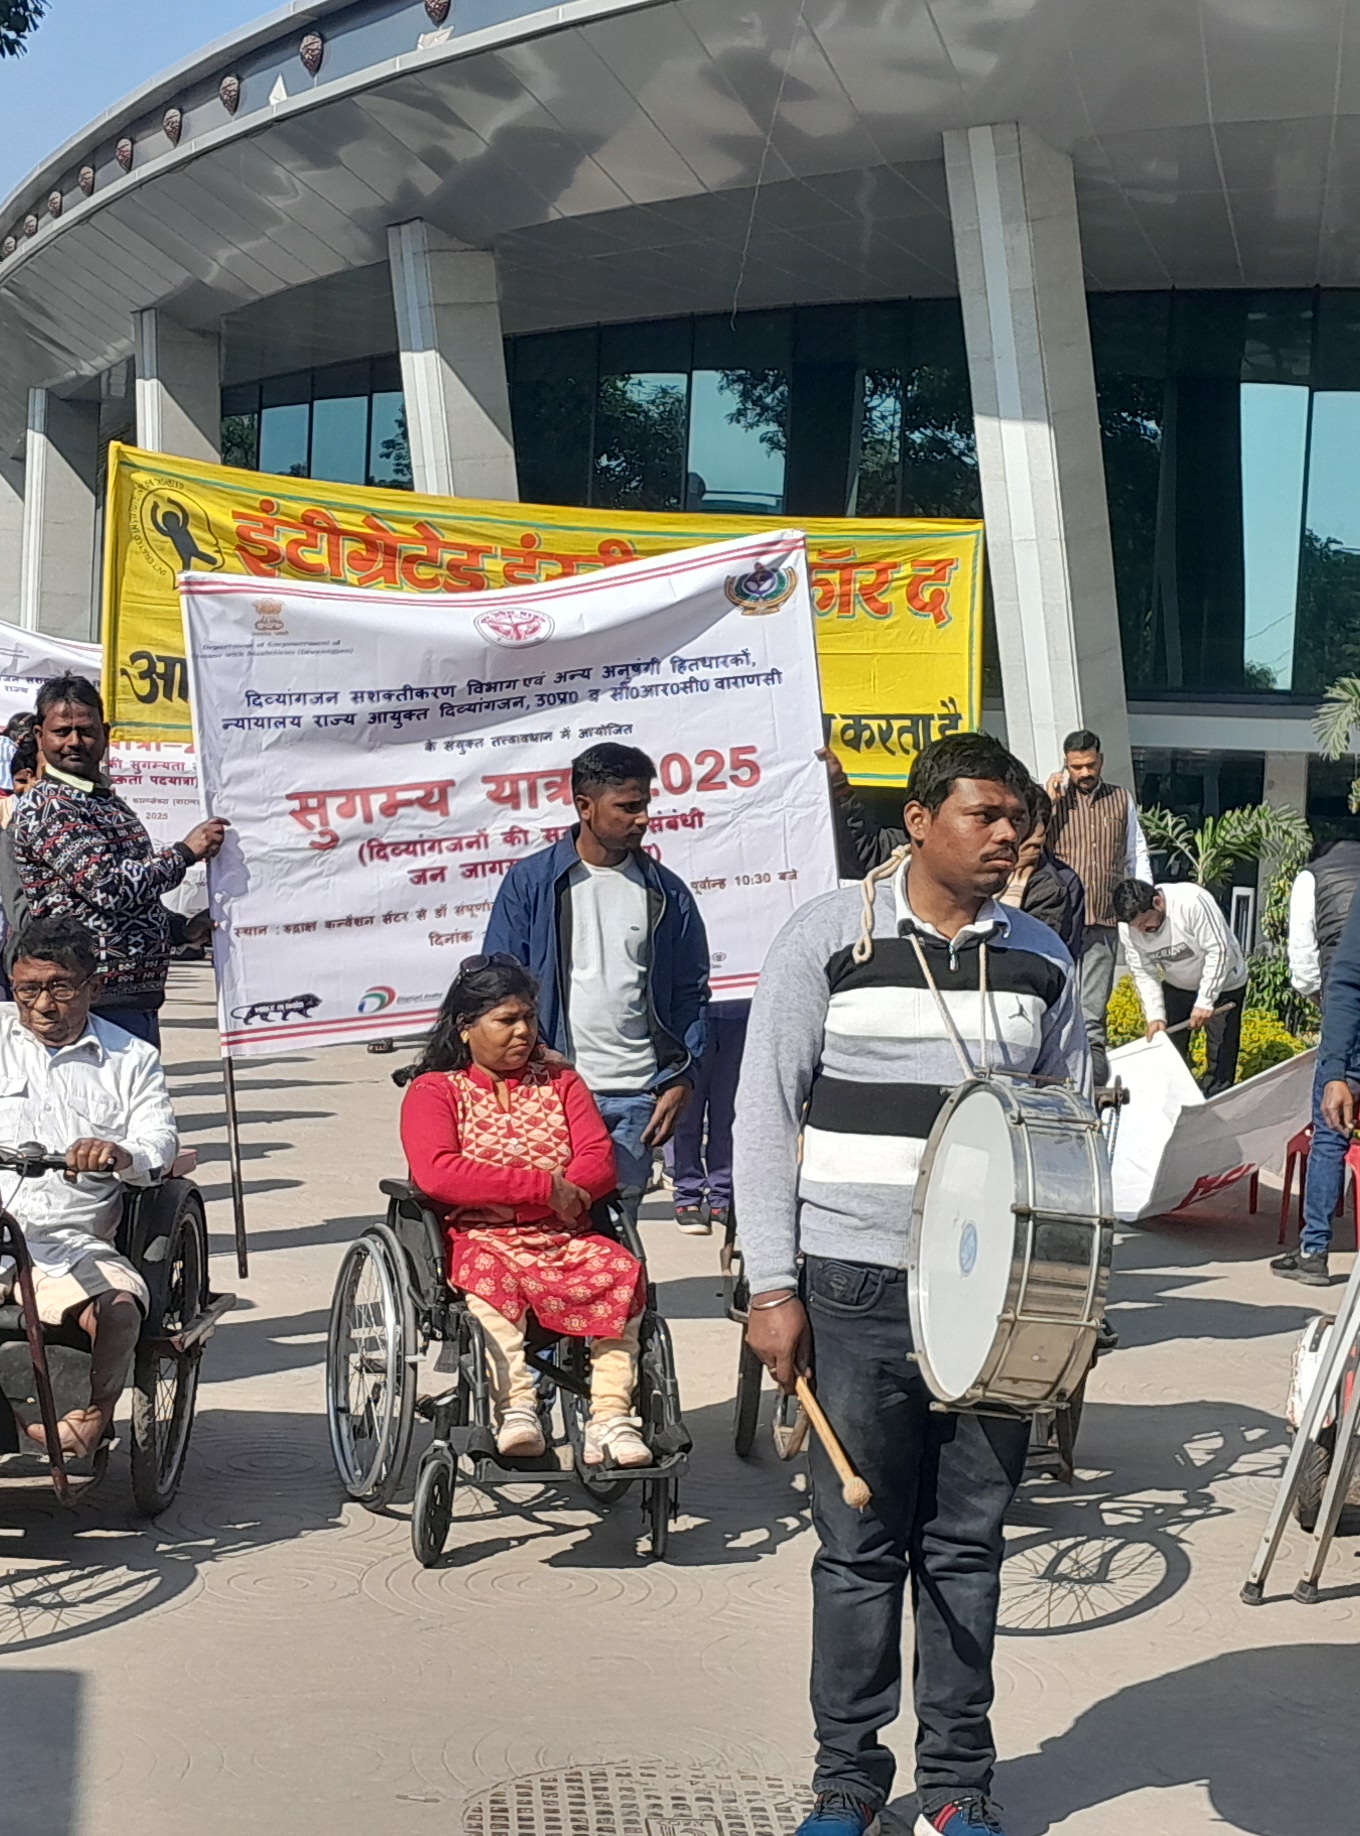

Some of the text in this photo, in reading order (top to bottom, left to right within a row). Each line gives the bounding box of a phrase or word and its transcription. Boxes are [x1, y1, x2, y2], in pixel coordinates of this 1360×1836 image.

[231, 498, 497, 592] इंटीग्रेटेड
[906, 558, 958, 628] द
[222, 715, 302, 731] न्यायालय
[313, 713, 358, 728] राज्य
[367, 706, 430, 729] आयुक्त
[440, 694, 530, 719] दिव्यांगजन,
[588, 687, 601, 703] व
[714, 669, 783, 690] वाराणसी
[245, 688, 339, 708] दिव्यांगजन
[350, 684, 456, 704] सशक्तीकरण
[467, 677, 519, 697] विभाग
[523, 673, 547, 688] एवं
[554, 667, 594, 684] अन्य
[424, 739, 437, 752] के
[443, 737, 484, 756] संयुक्त
[578, 723, 635, 740] आयोजित
[840, 713, 934, 756] करता
[285, 745, 762, 850] सुगम्य यात्र 025
[358, 828, 489, 868] (दिव्यांगजनों
[502, 825, 530, 847] की
[648, 807, 706, 834] संबंधी
[408, 865, 448, 886] जन
[233, 924, 268, 940] स्थान
[416, 907, 428, 921] से
[734, 872, 772, 887] 10:30
[778, 867, 799, 882] बजे
[428, 928, 474, 947] दिनांक
